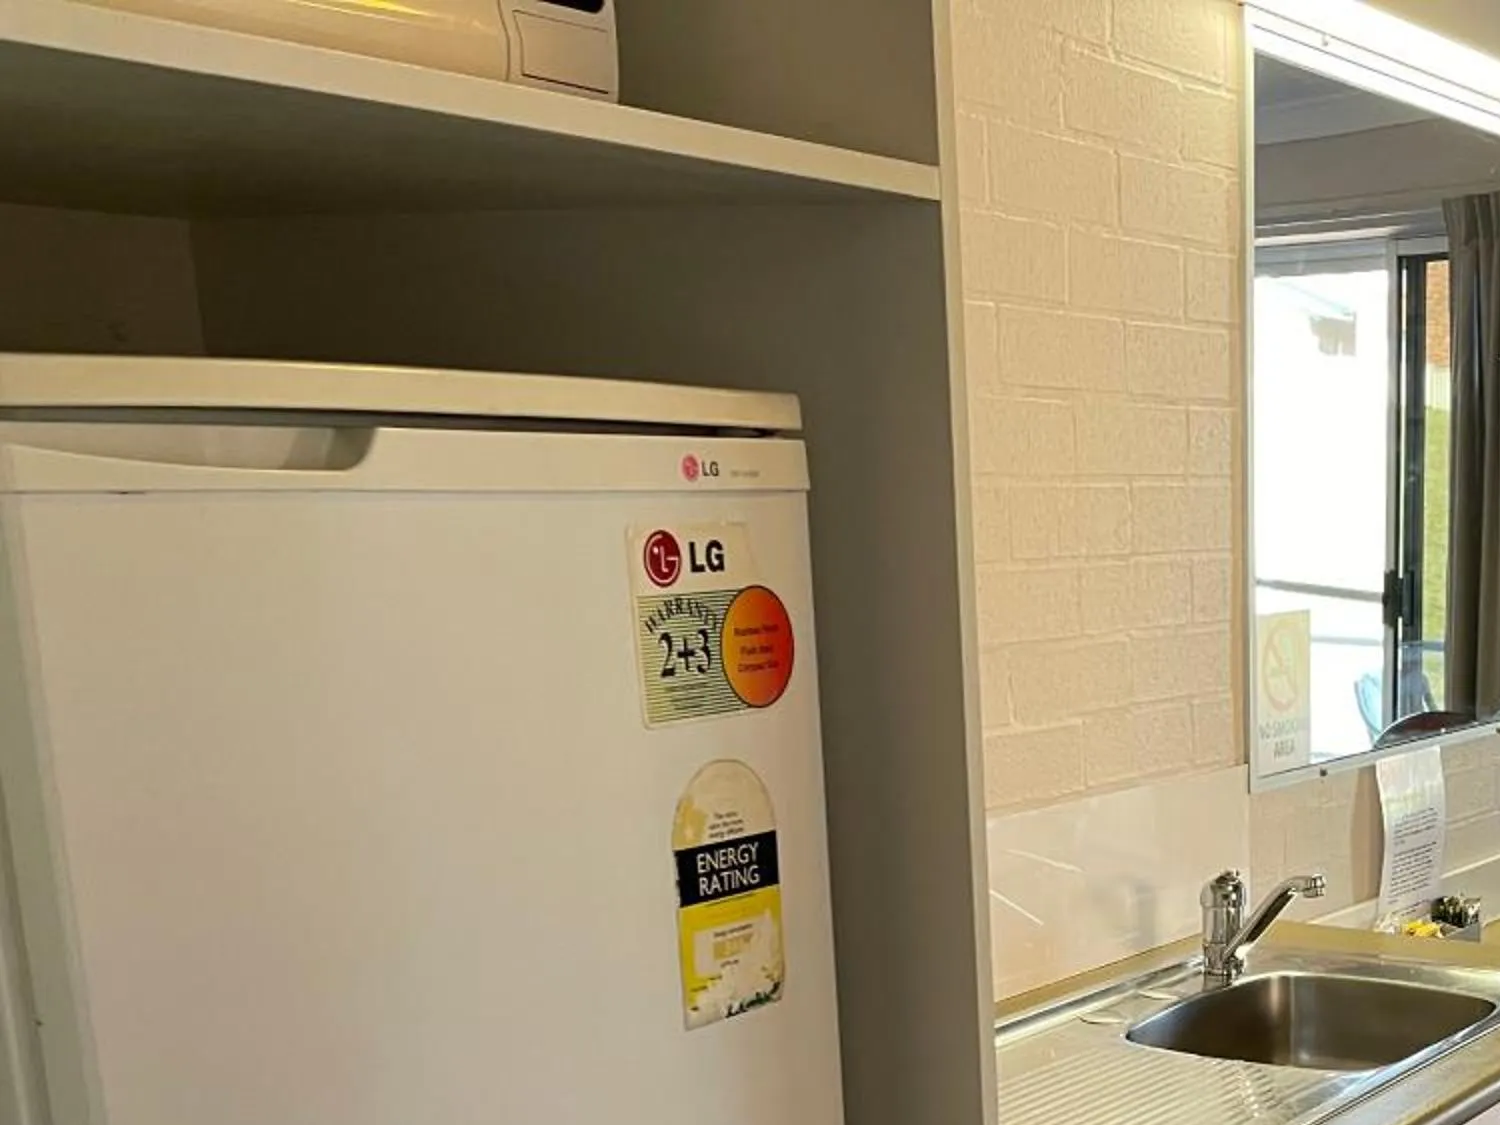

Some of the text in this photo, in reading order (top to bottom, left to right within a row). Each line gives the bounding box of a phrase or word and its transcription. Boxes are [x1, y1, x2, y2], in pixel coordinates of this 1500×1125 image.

[701, 460, 719, 477] LG
[688, 539, 725, 573] LG
[658, 628, 711, 678] 2+3
[696, 842, 759, 874] ENERGY
[699, 865, 761, 897] RATING
